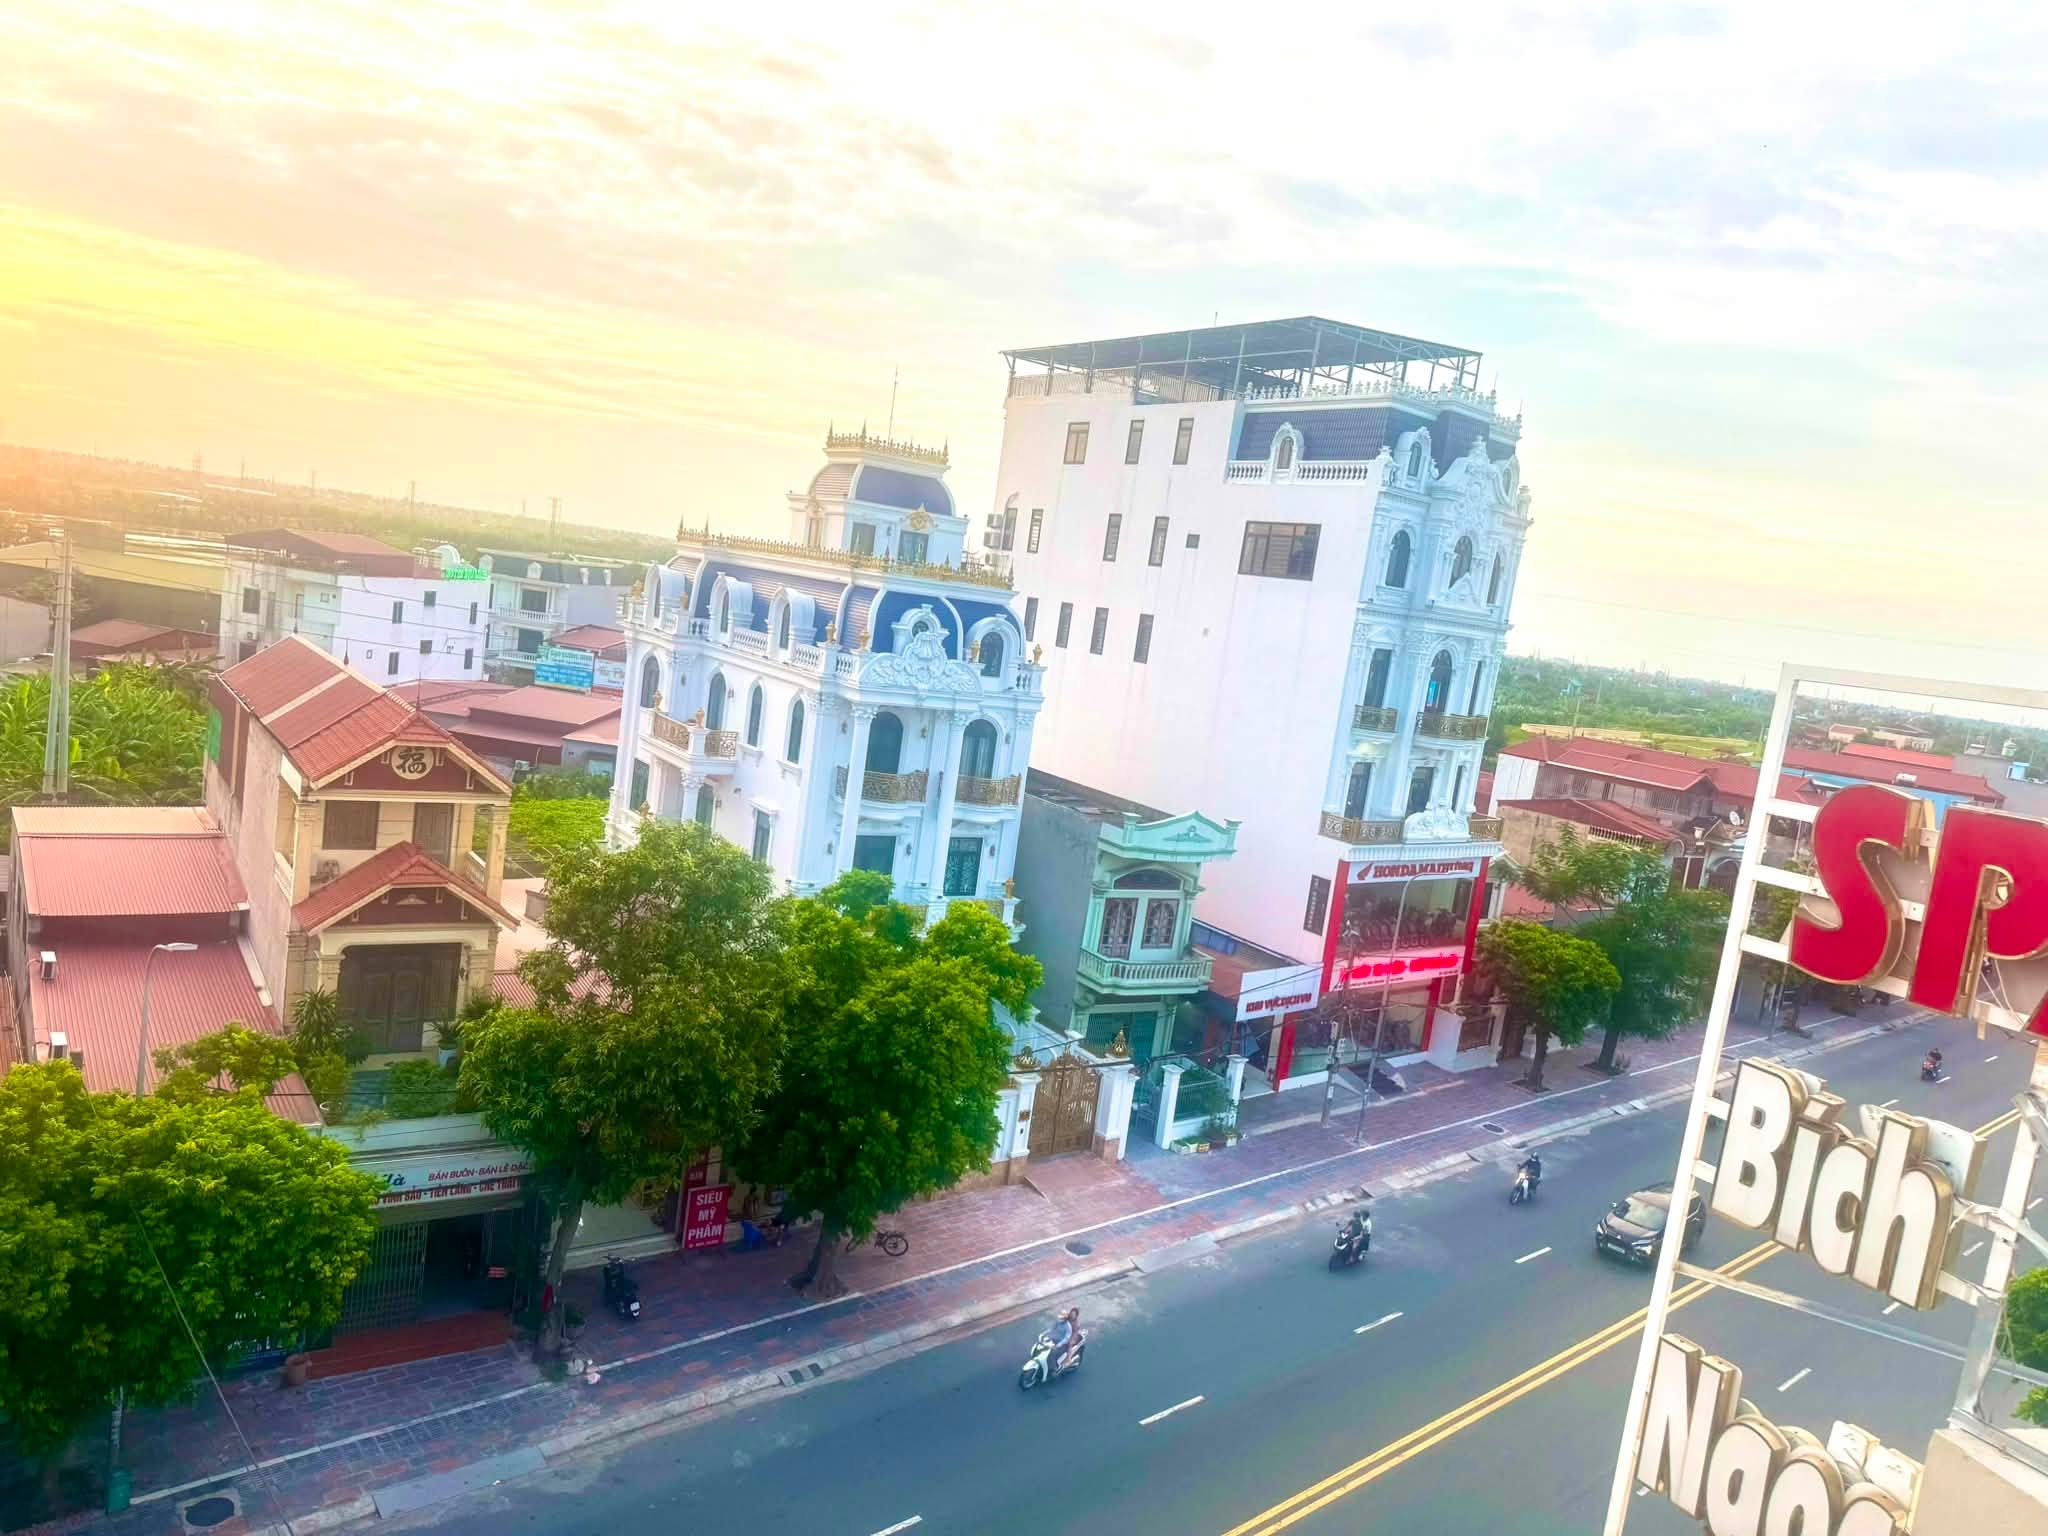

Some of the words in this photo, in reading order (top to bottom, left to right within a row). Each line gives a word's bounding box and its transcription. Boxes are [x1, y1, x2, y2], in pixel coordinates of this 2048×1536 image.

[1373, 863, 1417, 878] HONDA
[1788, 783, 2048, 1038] SP
[428, 1169, 448, 1181] BÁN
[450, 1167, 475, 1179] BUÔN
[479, 1164, 498, 1176] BÁN
[696, 1190, 723, 1205] SIÊU
